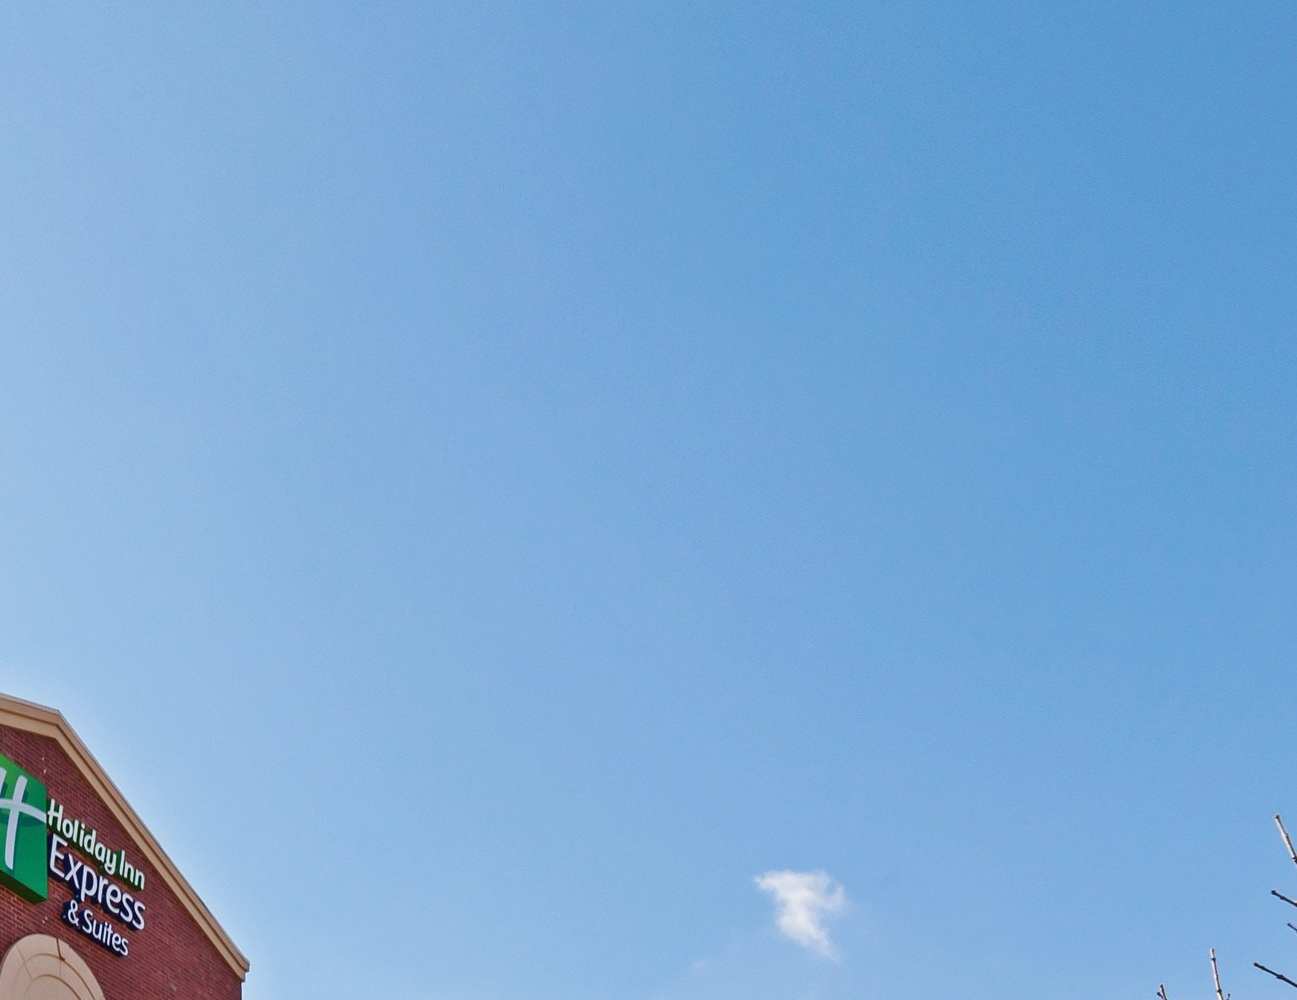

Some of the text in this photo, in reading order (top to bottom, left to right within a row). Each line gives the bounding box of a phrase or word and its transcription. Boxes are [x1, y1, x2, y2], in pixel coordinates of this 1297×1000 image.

[48, 798, 145, 890] Holiday Inn
[49, 833, 146, 930] Express
[67, 899, 129, 956] & Suites
